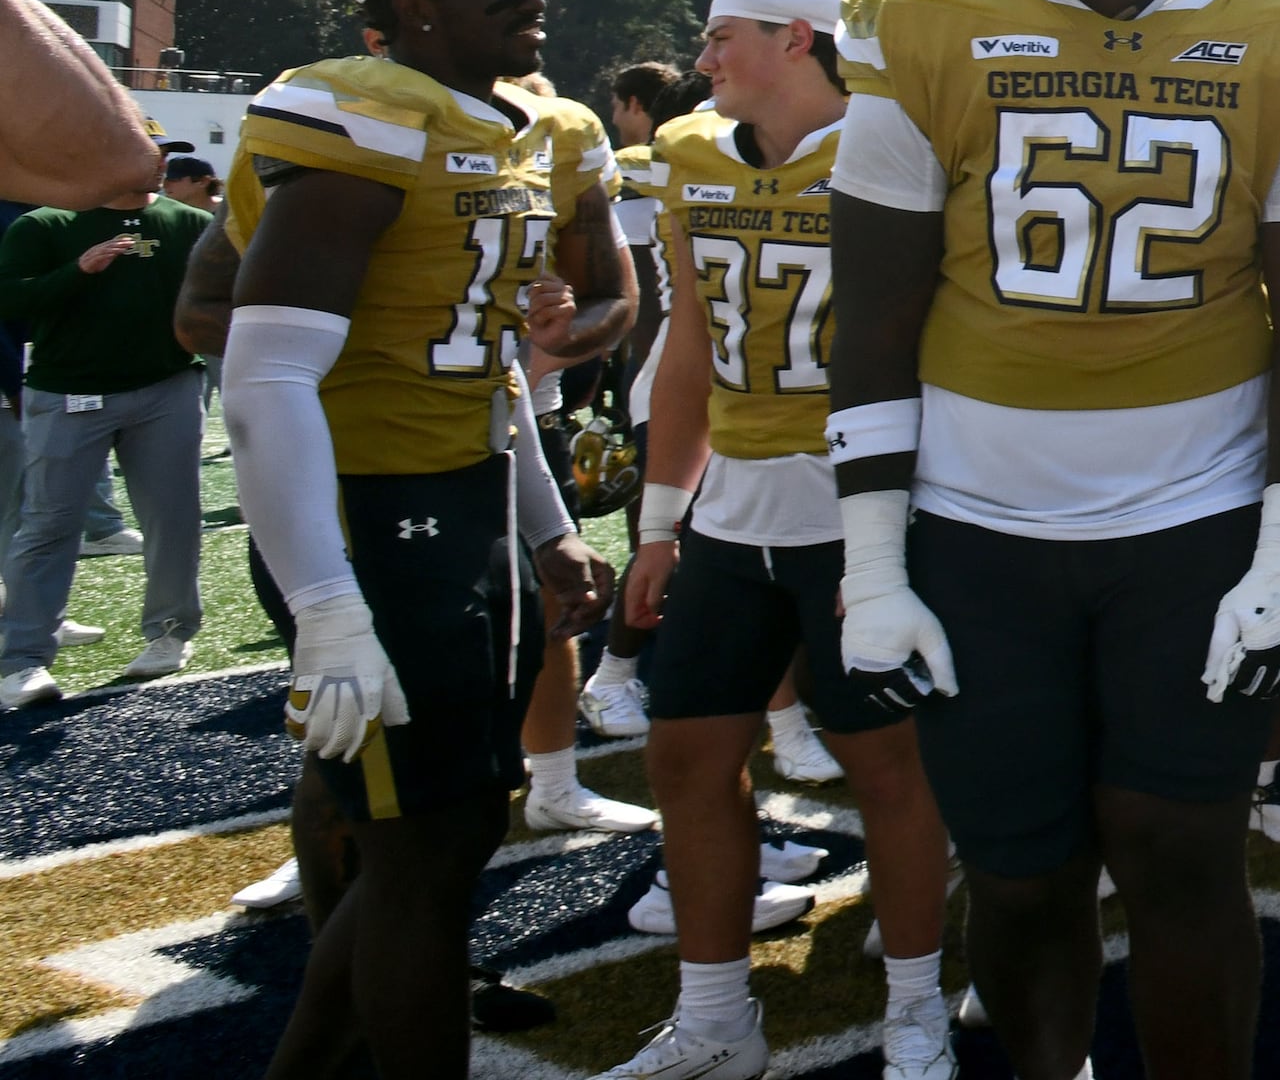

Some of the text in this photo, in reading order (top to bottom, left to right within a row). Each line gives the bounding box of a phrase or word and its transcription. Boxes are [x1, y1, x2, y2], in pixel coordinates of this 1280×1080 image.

[1002, 41, 1050, 54] Veritiv
[1183, 42, 1244, 59] ACC
[987, 70, 1241, 109] GEORGIA TECH
[700, 189, 730, 201] Veritiv
[782, 210, 832, 234] TEC
[985, 106, 1232, 314] 62
[689, 232, 833, 395] 37
